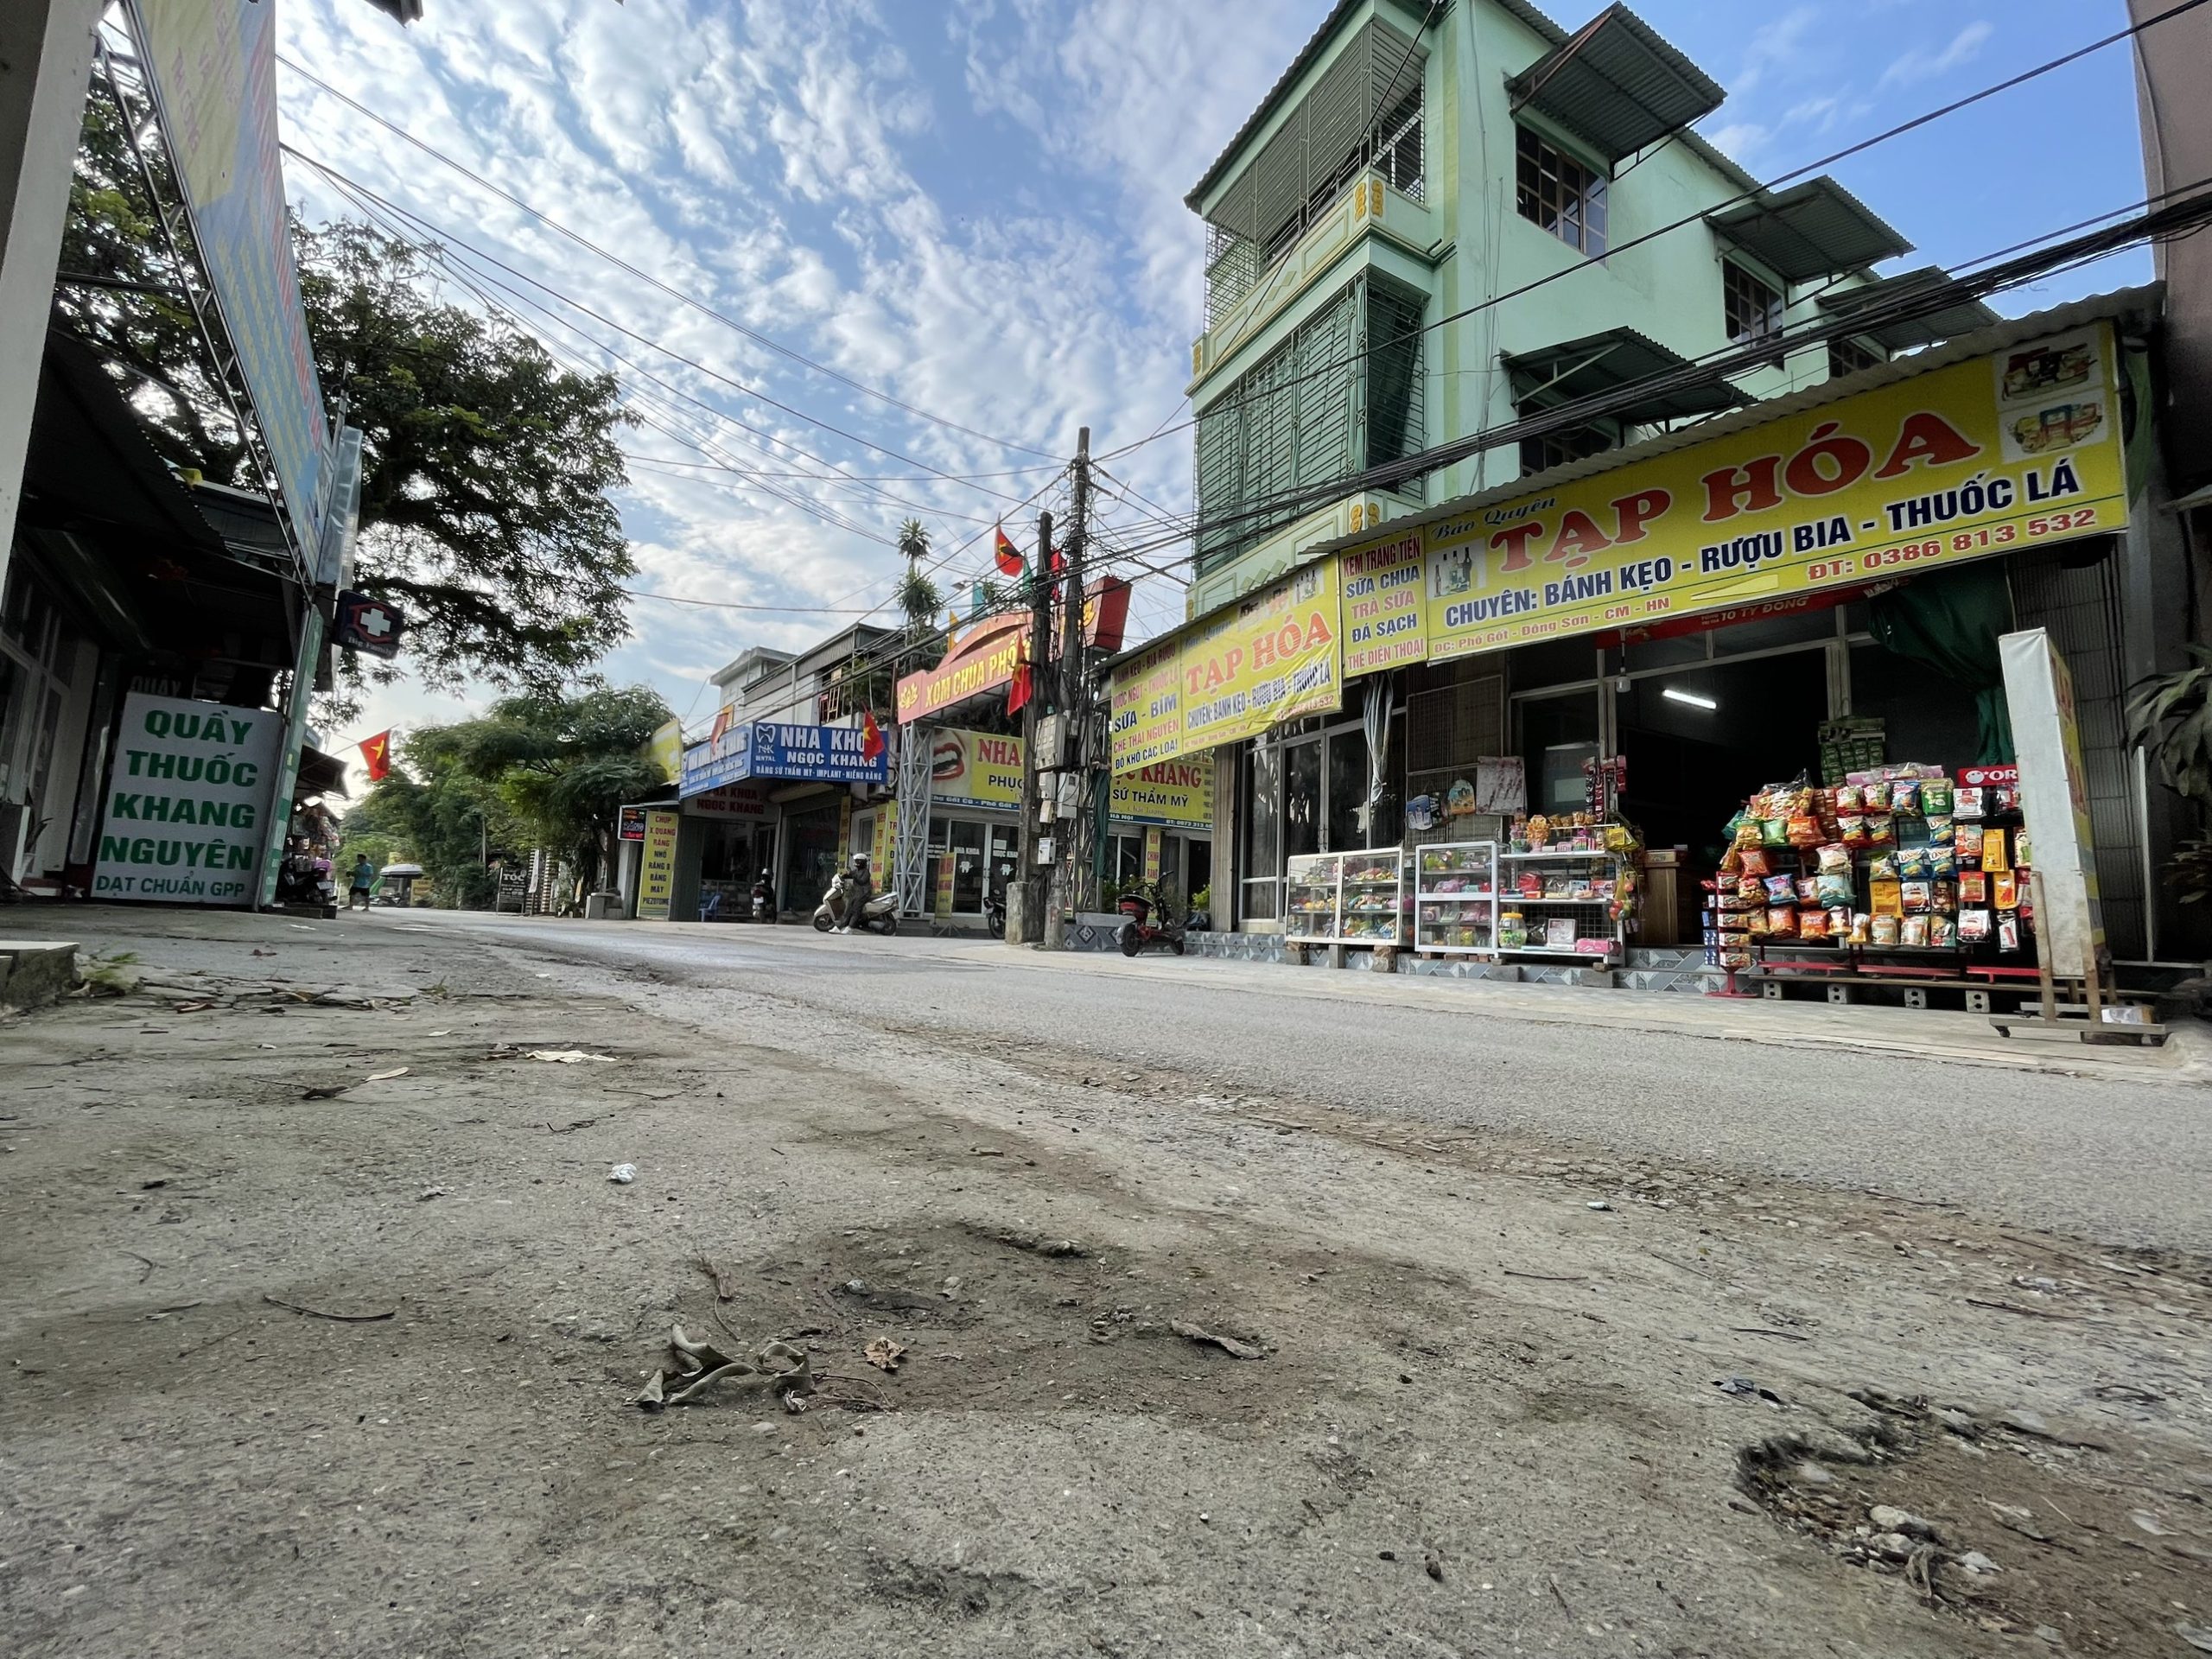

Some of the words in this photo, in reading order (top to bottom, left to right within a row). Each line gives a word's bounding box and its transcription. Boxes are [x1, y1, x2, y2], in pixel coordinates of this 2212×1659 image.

[1490, 489, 1671, 570] TẠP
[1701, 413, 1981, 523] HÓA
[1484, 496, 1556, 526] Quyên
[1446, 589, 1537, 627] CHUYÊN:
[1545, 568, 1611, 607] BÁNH
[1620, 556, 1672, 591] KẸO
[1700, 530, 1783, 573] RƯỢU
[1794, 516, 1852, 554] BIA
[1886, 472, 2013, 532] THUỐC
[2027, 457, 2080, 503] LÁ
[1808, 558, 1853, 582] ĐT:
[1863, 540, 1942, 570] 0386
[1952, 527, 2016, 553] 813
[2027, 508, 2097, 537] 532
[1343, 556, 1363, 578] KEM
[1346, 577, 1376, 599] SỮA
[1380, 565, 1421, 589] CHUA
[1351, 598, 1380, 620] TRÀ
[1384, 590, 1415, 611] SỮA
[1352, 623, 1371, 643] ĐÁ
[1376, 613, 1417, 637] SẠCH
[1459, 632, 1483, 649] Phố
[1486, 627, 1508, 644] Gốt
[1521, 620, 1556, 639] Đông
[1561, 612, 1590, 627] Sơn
[1605, 605, 1630, 620] CM
[1646, 597, 1669, 612] HN
[1185, 648, 1243, 695] TẠP
[1252, 612, 1332, 671] HÓA
[1348, 649, 1365, 671] THẺ
[1368, 645, 1391, 665] ĐIỆN
[1394, 638, 1424, 658] THOẠI
[925, 674, 950, 708] XÓM
[953, 659, 985, 696] CHÙA
[1115, 709, 1137, 733] SỮA
[1213, 695, 1231, 721] BÁNH
[1233, 691, 1246, 717] KẸO
[144, 709, 253, 746] QUẦY
[780, 726, 821, 750] NHA
[830, 730, 866, 753] KHO
[1147, 718, 1179, 741] NGUYÊN
[786, 751, 824, 767] NGỌC
[830, 754, 878, 768] KHANG
[978, 738, 1022, 767] NHA
[1142, 744, 1158, 760] CÁC
[126, 749, 257, 787] THUỐC
[816, 768, 842, 779] IMPLANT
[1141, 762, 1203, 788] KHANG
[112, 792, 256, 830] KHANG
[729, 802, 765, 815] KHANG
[1112, 787, 1128, 800] SỨ
[1132, 786, 1166, 805] THẨM
[1171, 794, 1189, 807] MỸ
[99, 836, 254, 872] NGUYÊN
[140, 870, 206, 897] CHUẨN
[210, 880, 245, 898] GPP
